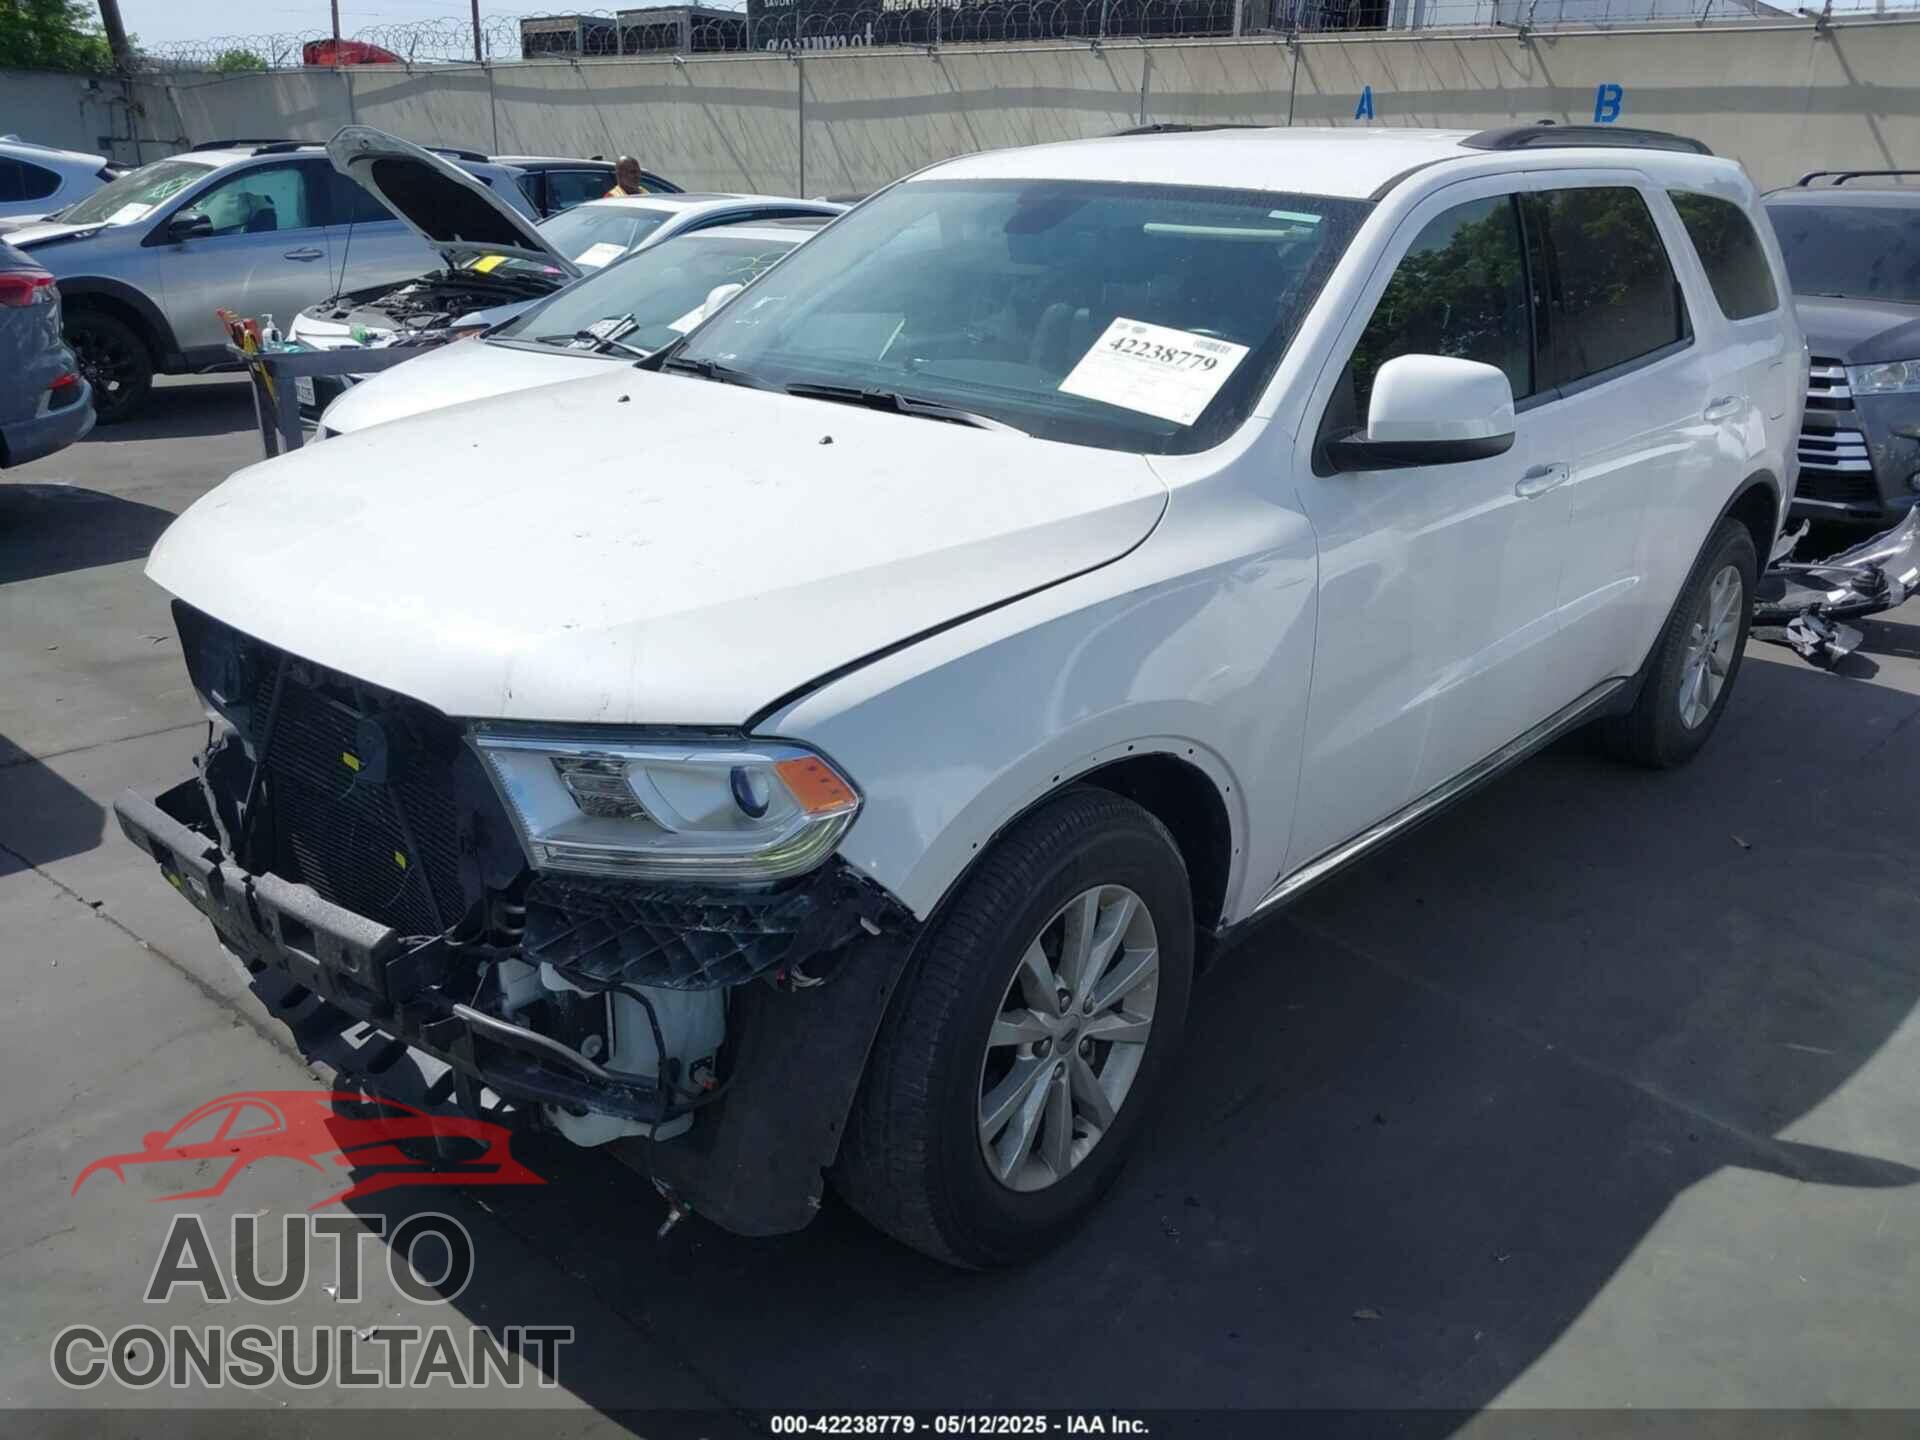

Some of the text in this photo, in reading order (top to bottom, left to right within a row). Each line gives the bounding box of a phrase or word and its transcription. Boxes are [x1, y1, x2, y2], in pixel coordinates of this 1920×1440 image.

[1355, 85, 1374, 120] A
[1594, 83, 1624, 123] B
[1109, 336, 1218, 372] 42238779
